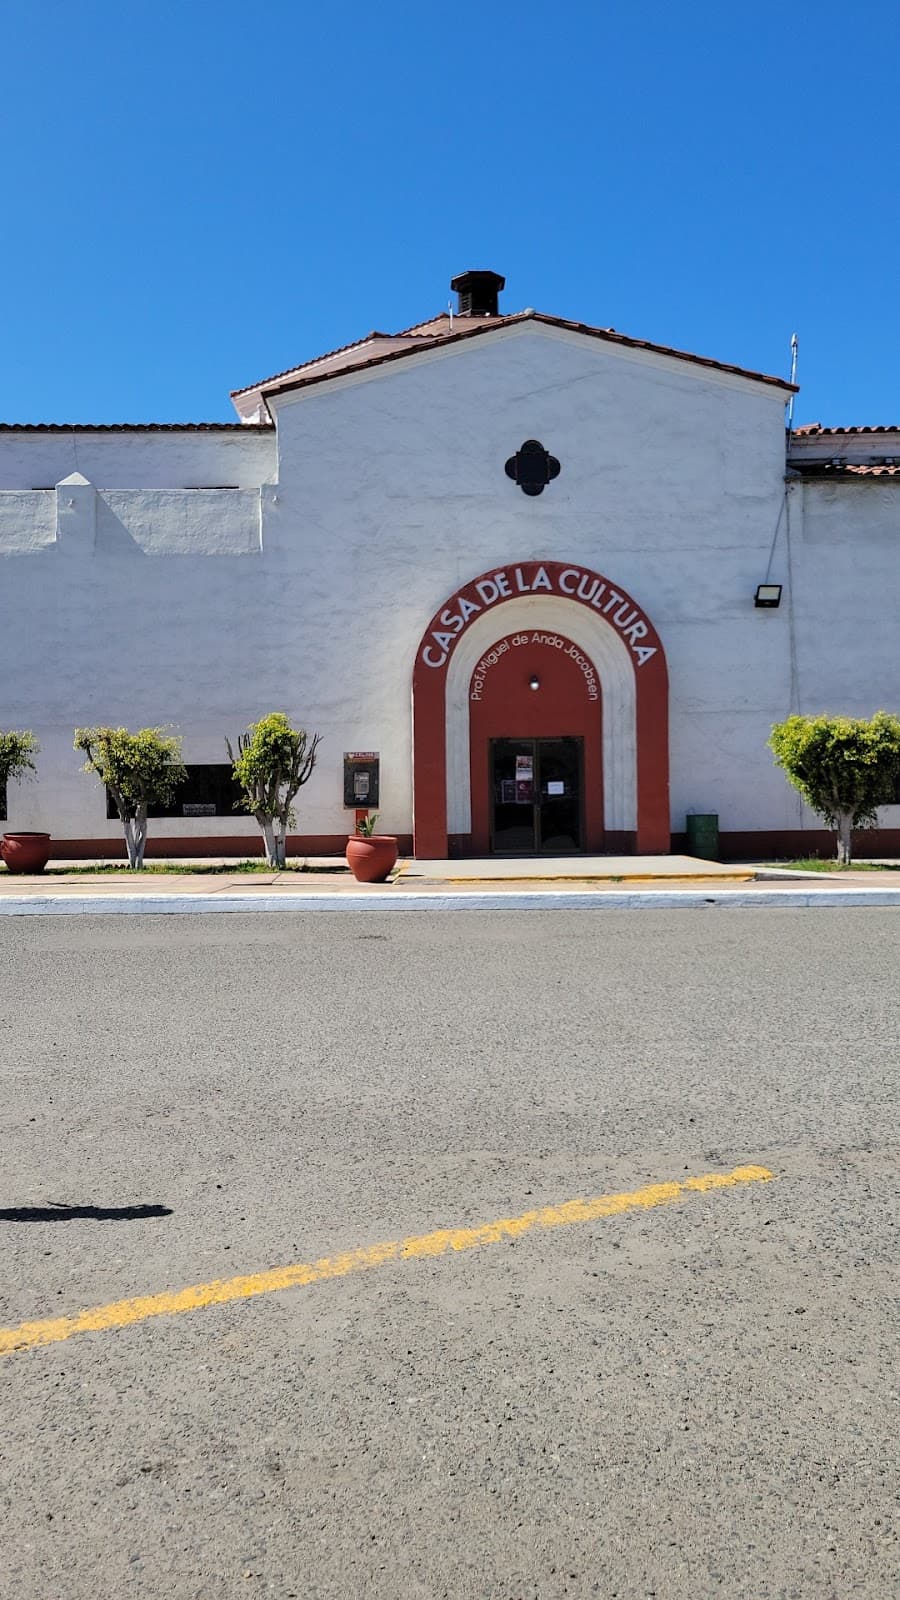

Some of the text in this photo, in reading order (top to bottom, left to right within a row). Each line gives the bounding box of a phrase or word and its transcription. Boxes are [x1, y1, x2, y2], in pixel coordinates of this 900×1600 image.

[423, 567, 657, 668] CASA DE LA CULTURA
[477, 640, 510, 674] Miguel
[512, 634, 529, 646] de
[531, 632, 564, 649] Anda
[563, 645, 598, 701] Jacobsen
